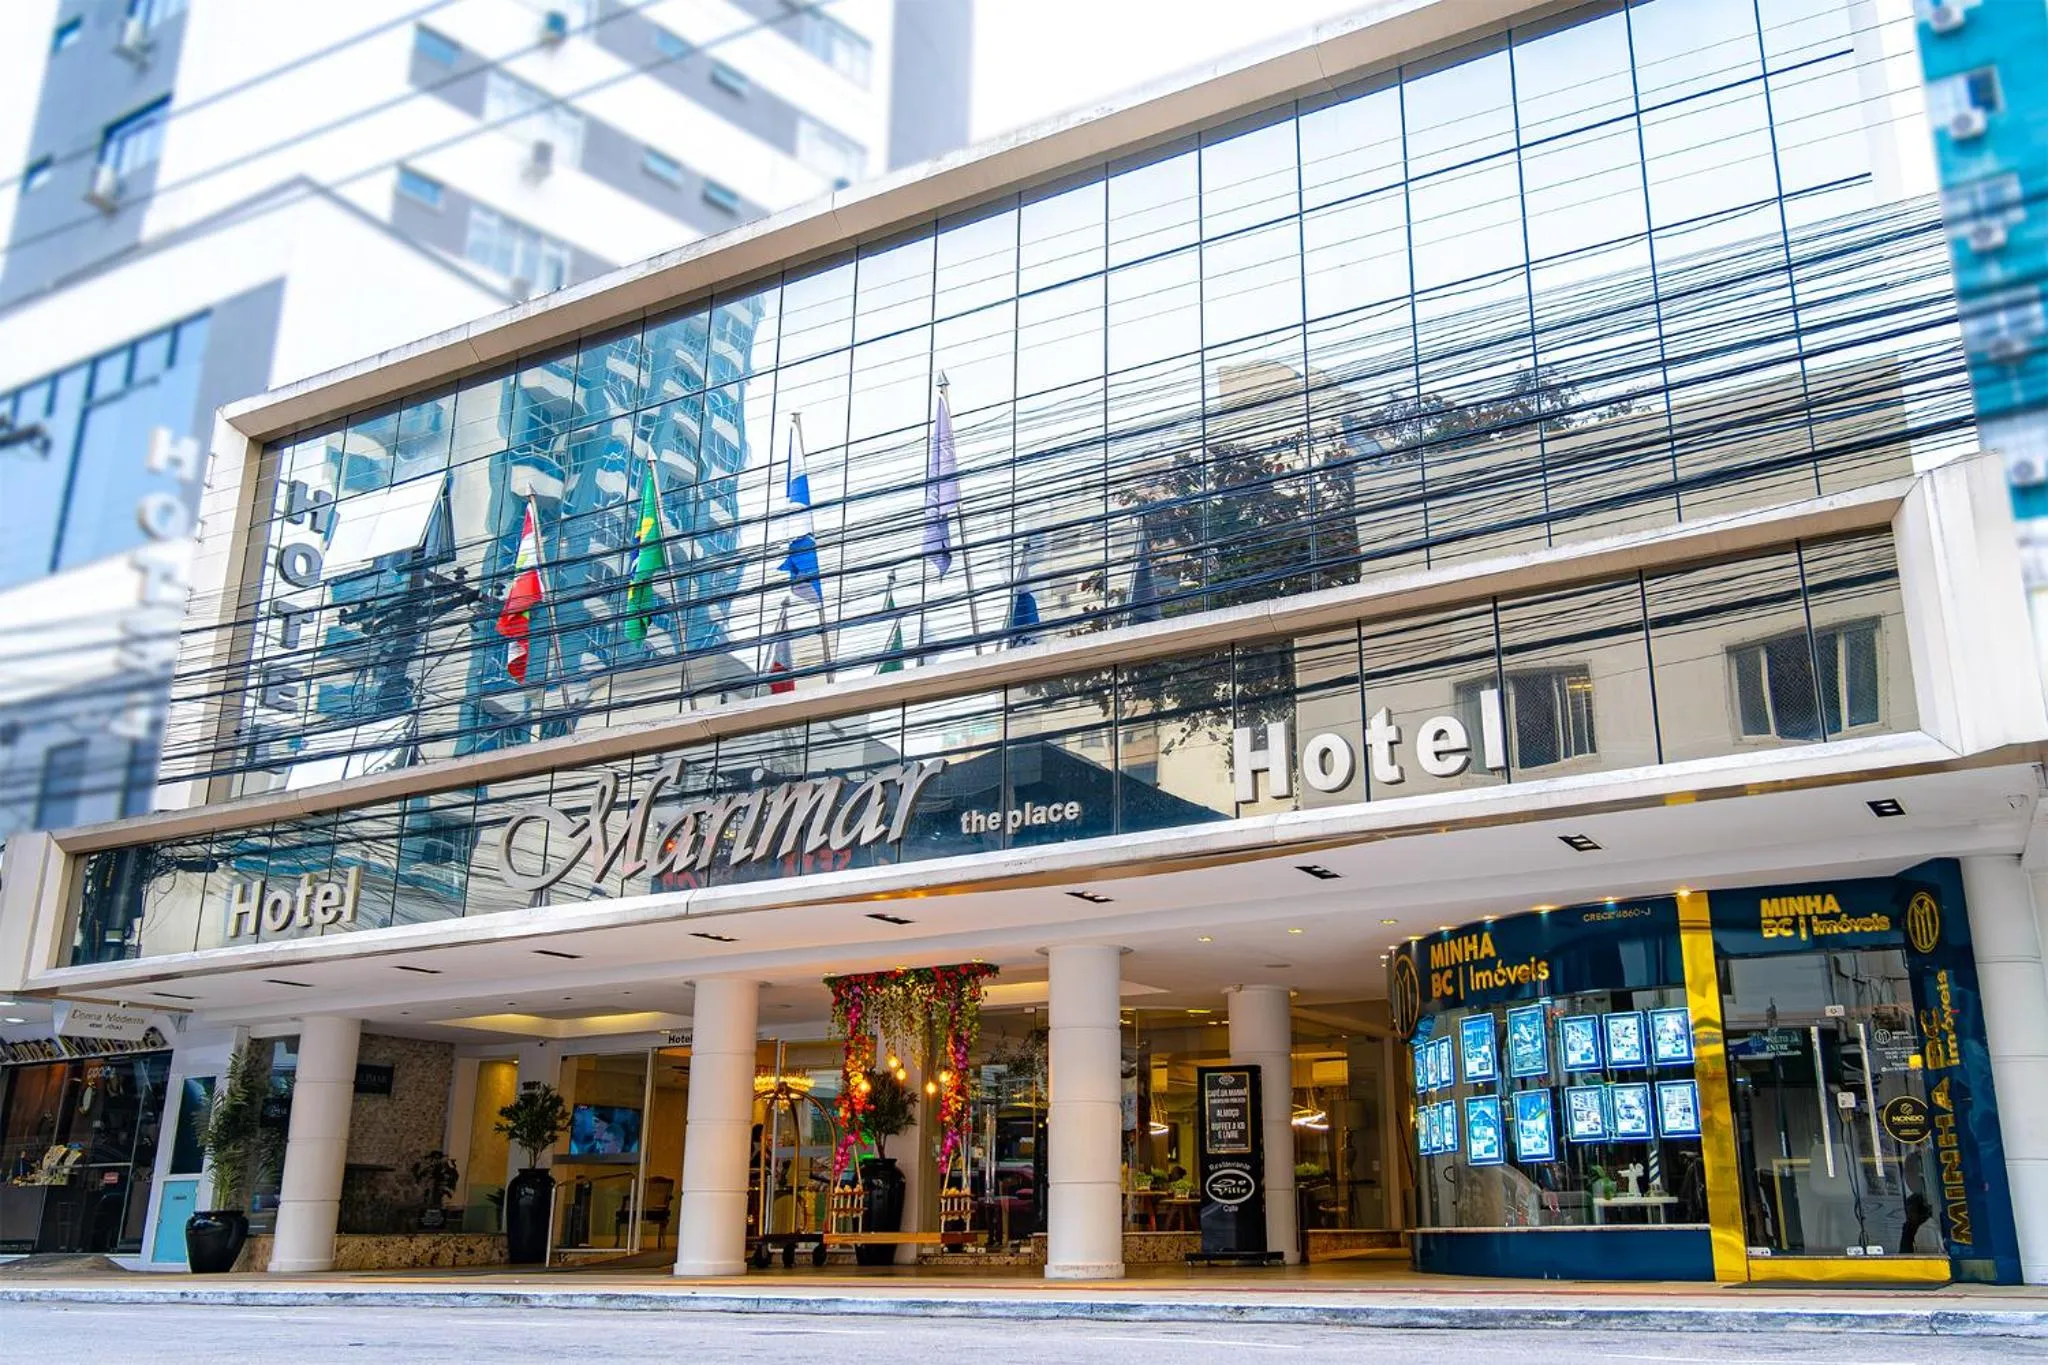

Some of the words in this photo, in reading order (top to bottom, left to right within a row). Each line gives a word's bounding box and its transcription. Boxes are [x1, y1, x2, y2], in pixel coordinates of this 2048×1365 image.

[1232, 688, 1509, 806] Hotel
[499, 757, 947, 892] Marimar
[961, 806, 1001, 834] the
[1004, 800, 1082, 836] place
[228, 866, 363, 938] Hotel
[1760, 893, 1841, 918] MINHA
[1761, 917, 1794, 939] BC
[1812, 912, 1891, 935] Imóveis
[1430, 932, 1496, 970] MINHA
[1431, 972, 1455, 998] BC
[1470, 956, 1550, 991] Imóveis
[668, 1033, 693, 1044] Hotel
[1920, 1008, 1946, 1071] BC
[1935, 969, 1961, 1066] Imóveis
[1932, 1076, 1973, 1246] MINHA
